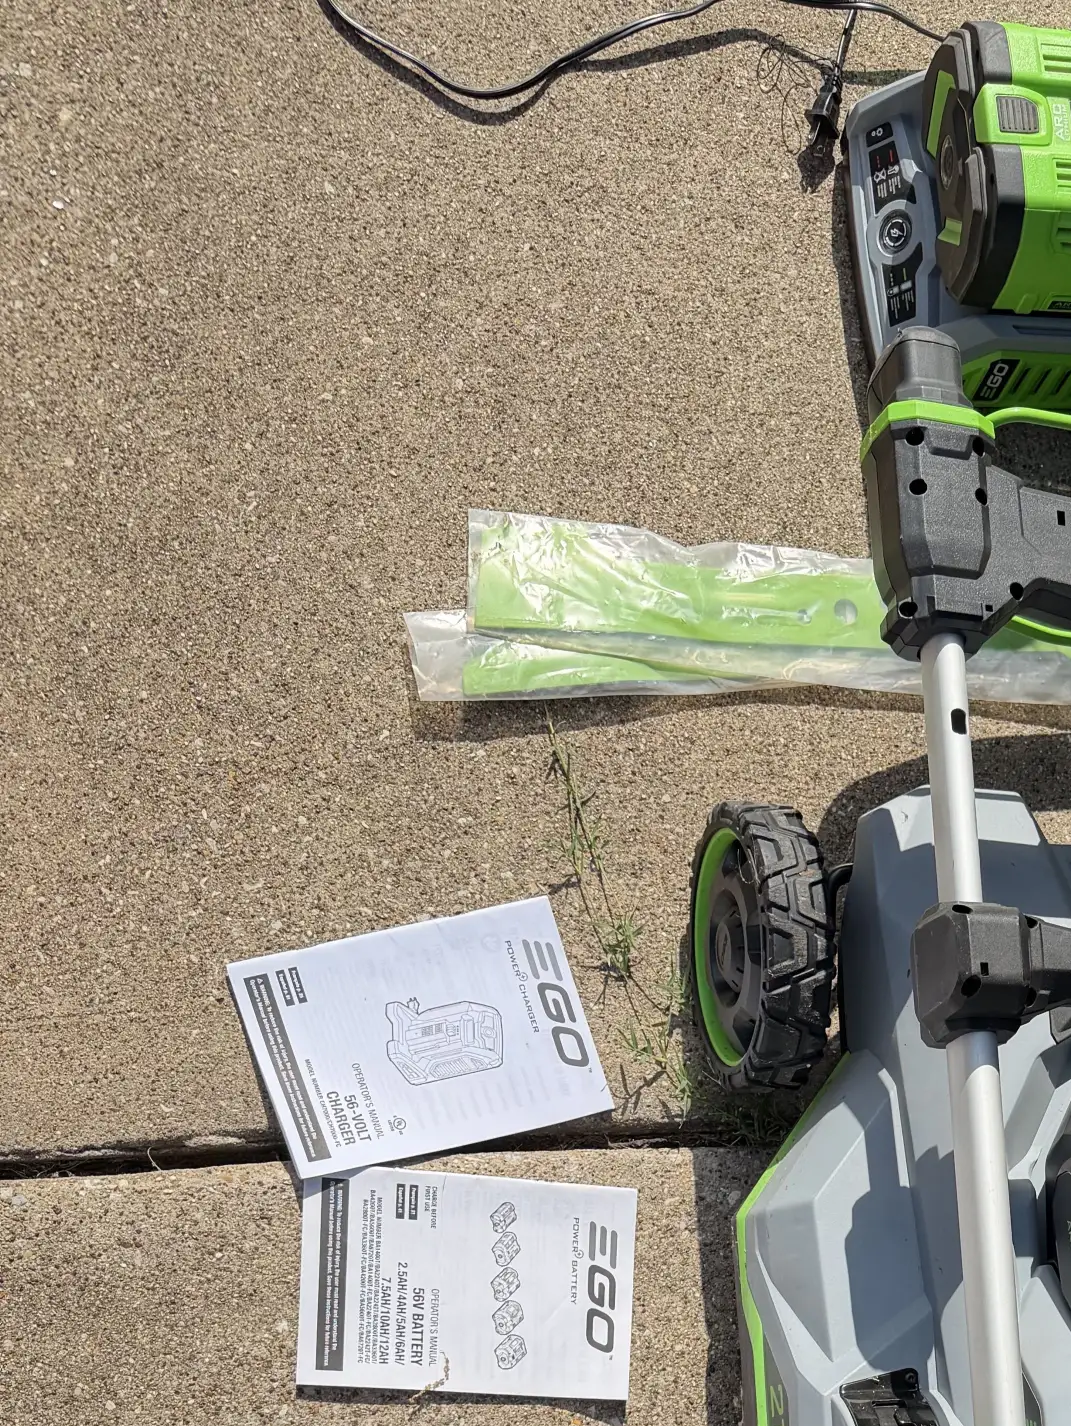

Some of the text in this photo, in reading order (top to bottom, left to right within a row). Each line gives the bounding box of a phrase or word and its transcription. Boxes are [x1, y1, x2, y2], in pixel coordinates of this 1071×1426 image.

[1052, 103, 1065, 140] ARC
[980, 364, 1009, 399] EGO
[518, 984, 539, 1032] CHARGER
[521, 939, 589, 1067] EGO
[304, 1059, 314, 1076] MODEL
[312, 1078, 322, 1098] NUMBER
[351, 1062, 384, 1138] OPERATOR'S MANUAL
[326, 1091, 355, 1145] CHARGER
[344, 1094, 371, 1140] 56-VOLT
[394, 1261, 408, 1365] 2.5AH/4AH/5AH/6AH/
[570, 1260, 578, 1304] BATTERY
[584, 1221, 618, 1353] EGO
[378, 1276, 391, 1364] 7.5AH/10AH/12AH
[410, 1287, 424, 1365] 56V BATTERY
[428, 1288, 439, 1366] OPERATOR'S MANUAL
